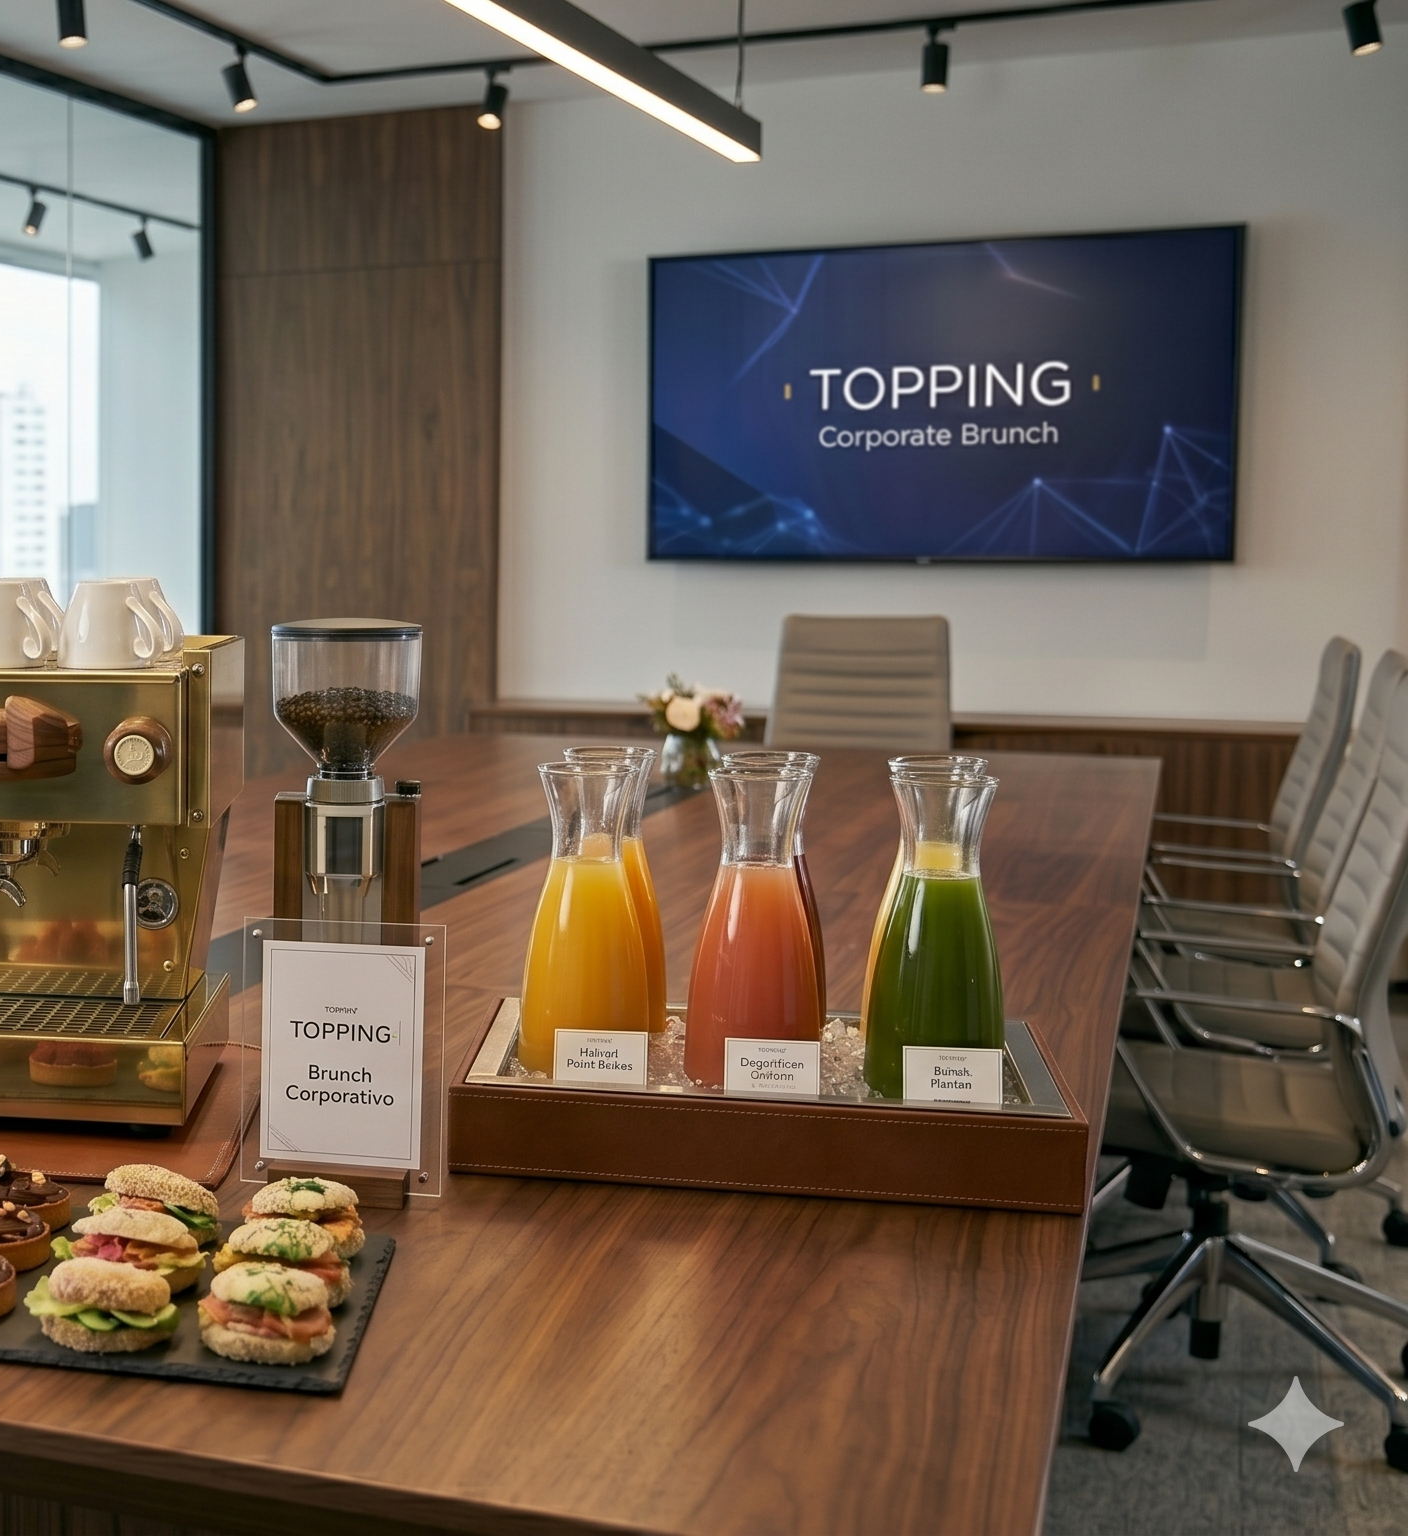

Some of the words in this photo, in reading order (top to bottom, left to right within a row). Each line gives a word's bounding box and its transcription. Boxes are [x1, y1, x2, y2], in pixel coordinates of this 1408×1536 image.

[809, 361, 1072, 411] TOPPING
[818, 425, 953, 451] Corporate
[961, 422, 1059, 446] Brunch
[290, 1020, 391, 1044] TOPPING
[308, 1064, 372, 1083] Brunch
[566, 1058, 595, 1069] Point
[285, 1084, 394, 1106] Corporativo
[930, 1078, 972, 1090] Plantan
